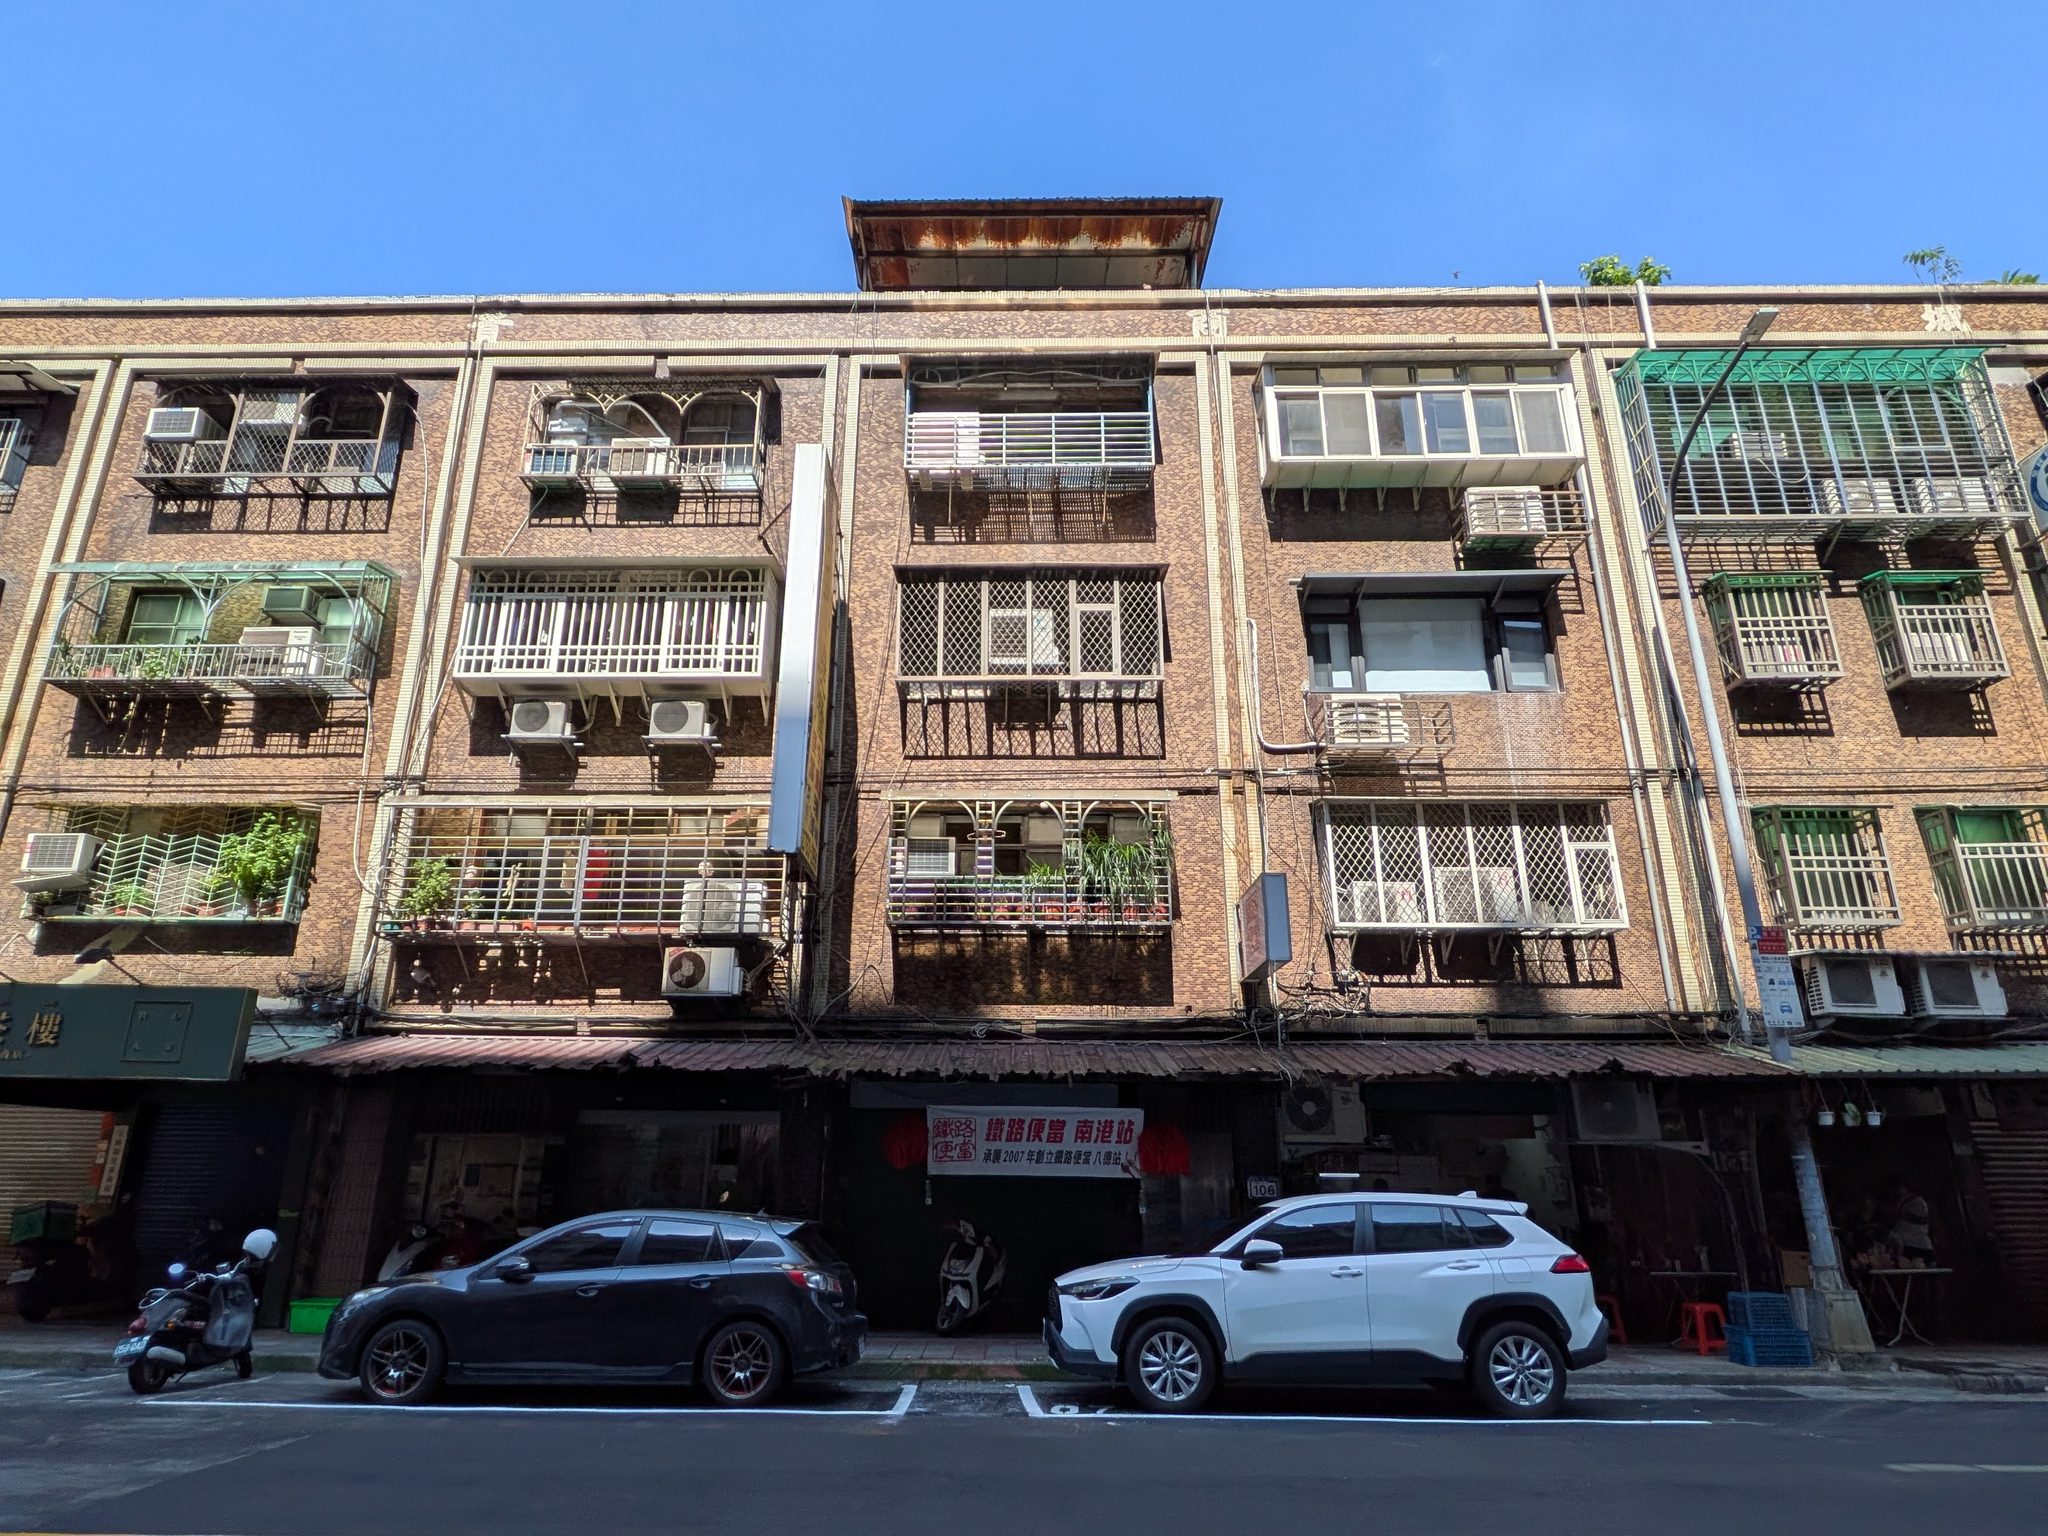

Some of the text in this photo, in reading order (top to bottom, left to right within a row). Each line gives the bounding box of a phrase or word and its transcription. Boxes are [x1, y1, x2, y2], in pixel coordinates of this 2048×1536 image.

[984, 1117, 1136, 1145] 鐵路便當 南港站
[1254, 1184, 1276, 1196] 106
